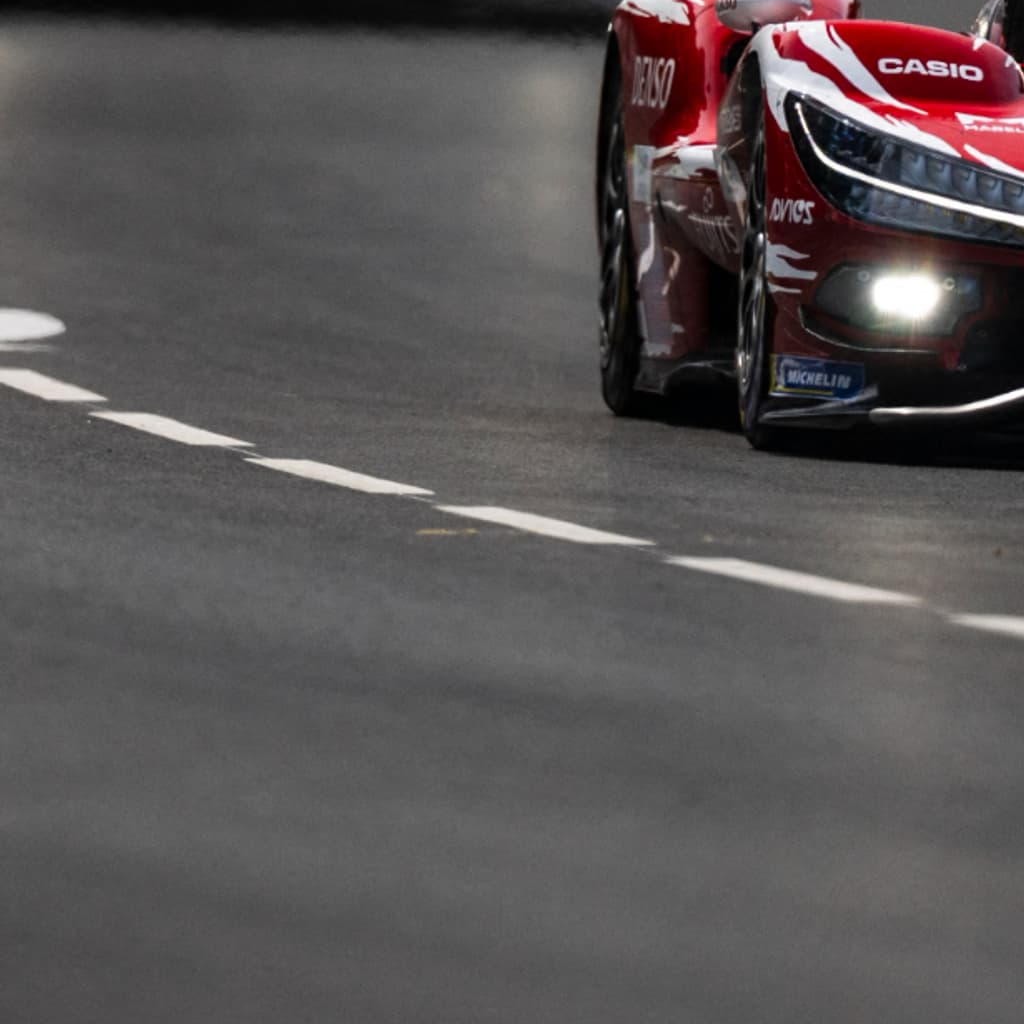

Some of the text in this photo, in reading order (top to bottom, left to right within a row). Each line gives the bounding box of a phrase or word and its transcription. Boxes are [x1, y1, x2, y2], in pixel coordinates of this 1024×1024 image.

[877, 58, 984, 81] CASIO
[631, 56, 675, 109] DENSO
[787, 369, 852, 389] MICHELIN
